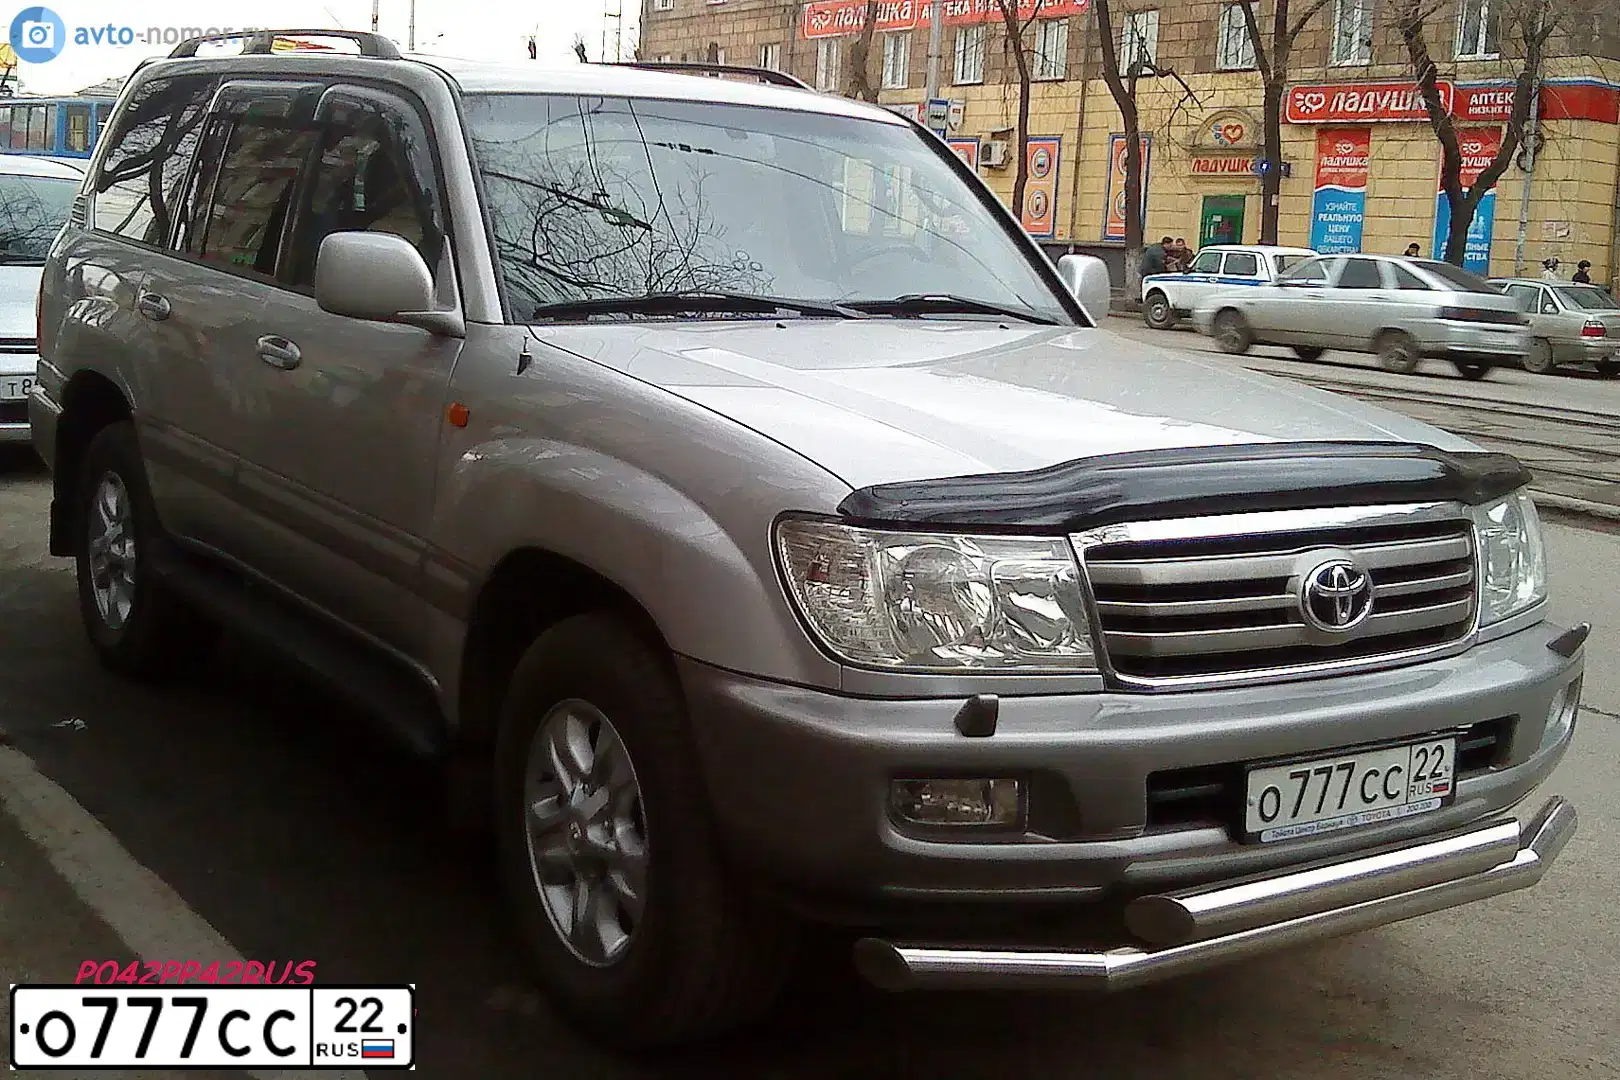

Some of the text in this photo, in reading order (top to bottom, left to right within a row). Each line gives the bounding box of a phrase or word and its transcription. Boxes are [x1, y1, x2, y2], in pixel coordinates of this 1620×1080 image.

[1470, 92, 1514, 105] АПТЕК
[1413, 744, 1445, 783] 22
[1409, 783, 1432, 797] RUS
[1362, 810, 1391, 822] TOYOTA
